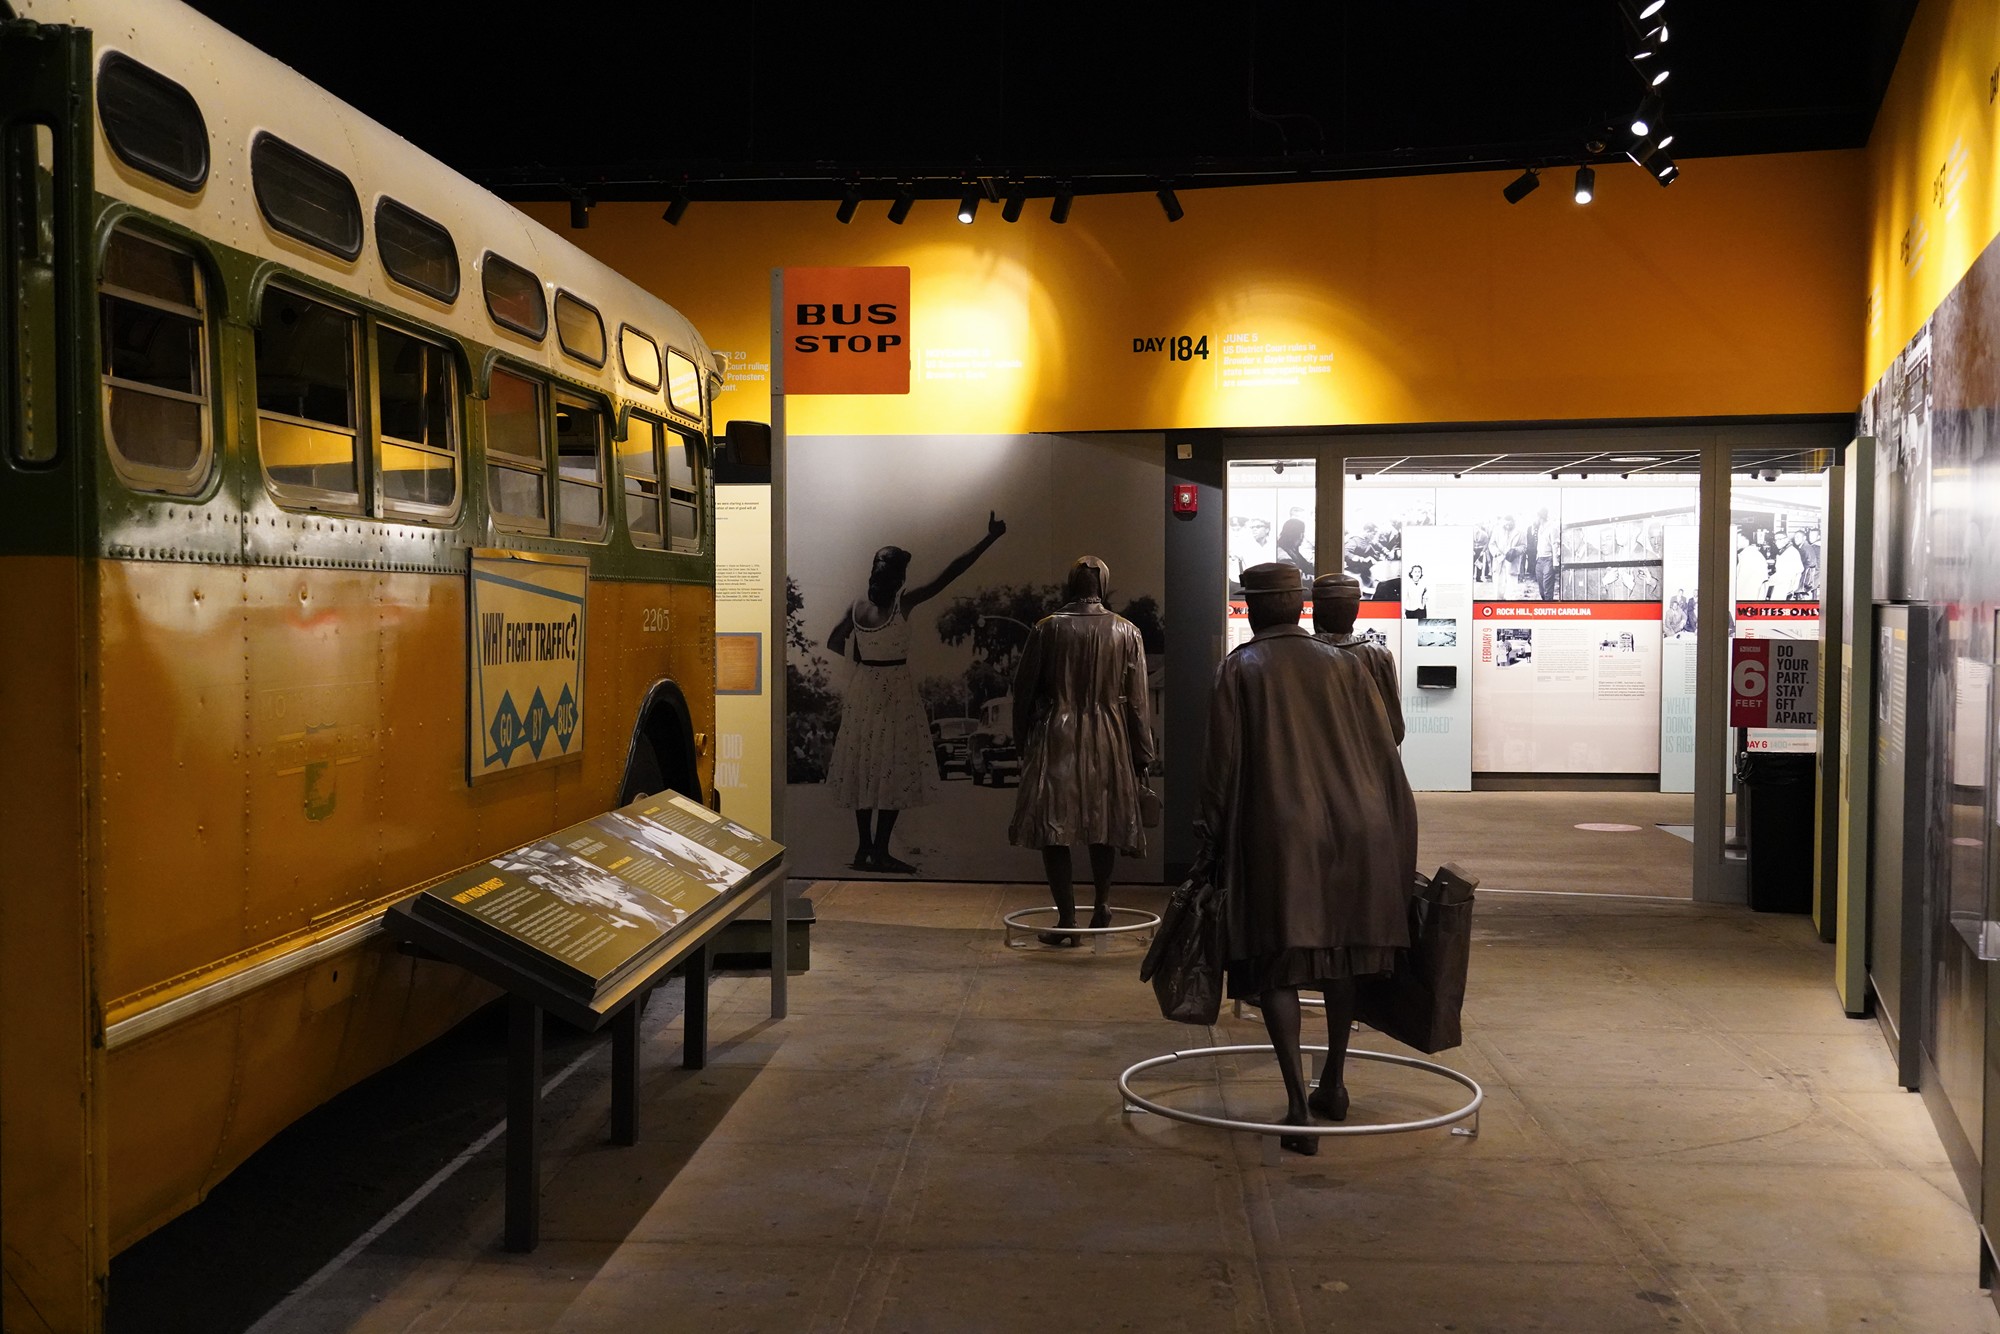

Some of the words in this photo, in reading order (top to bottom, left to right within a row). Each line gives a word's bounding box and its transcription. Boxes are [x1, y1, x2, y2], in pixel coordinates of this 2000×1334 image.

[797, 304, 897, 325] BUS
[795, 335, 902, 353] STOP
[1223, 333, 1250, 343] JUNE
[1133, 337, 1167, 353] DAY
[1170, 335, 1209, 361] 184
[1223, 345, 1234, 355] US
[1265, 343, 1287, 353] Court
[1308, 342, 1317, 351] in
[734, 351, 747, 360] 20
[1303, 354, 1318, 364] city
[1319, 352, 1334, 362] and
[748, 363, 769, 372] ruling
[1308, 365, 1332, 373] buses
[727, 373, 765, 381] Protesters
[1496, 608, 1515, 616] ROCK
[1516, 608, 1533, 617] HILL,
[1533, 607, 1556, 616] SOUTH
[1558, 607, 1591, 616] CAROLINA
[643, 608, 670, 632] 2265
[482, 613, 504, 666] WHY
[506, 622, 533, 663] FIGHT
[535, 613, 577, 661] TRAFFIC?
[1482, 634, 1492, 663] FEBRUARY
[1777, 645, 1793, 657] DO
[1777, 659, 1809, 671] YOUR
[1733, 659, 1766, 697] 6
[1777, 672, 1809, 684] PART.
[1776, 685, 1804, 697] STAY
[1411, 696, 1429, 713] FELT
[1735, 699, 1763, 708] FEET
[1776, 699, 1795, 710] 6FT
[1775, 712, 1816, 724] APART.
[500, 713, 513, 747] GO
[532, 707, 544, 742] BY
[558, 703, 573, 735] BUS
[1666, 716, 1692, 734] DOING
[722, 734, 743, 759] DID
[1666, 736, 1674, 752] IS
[1762, 741, 1768, 749] 6
